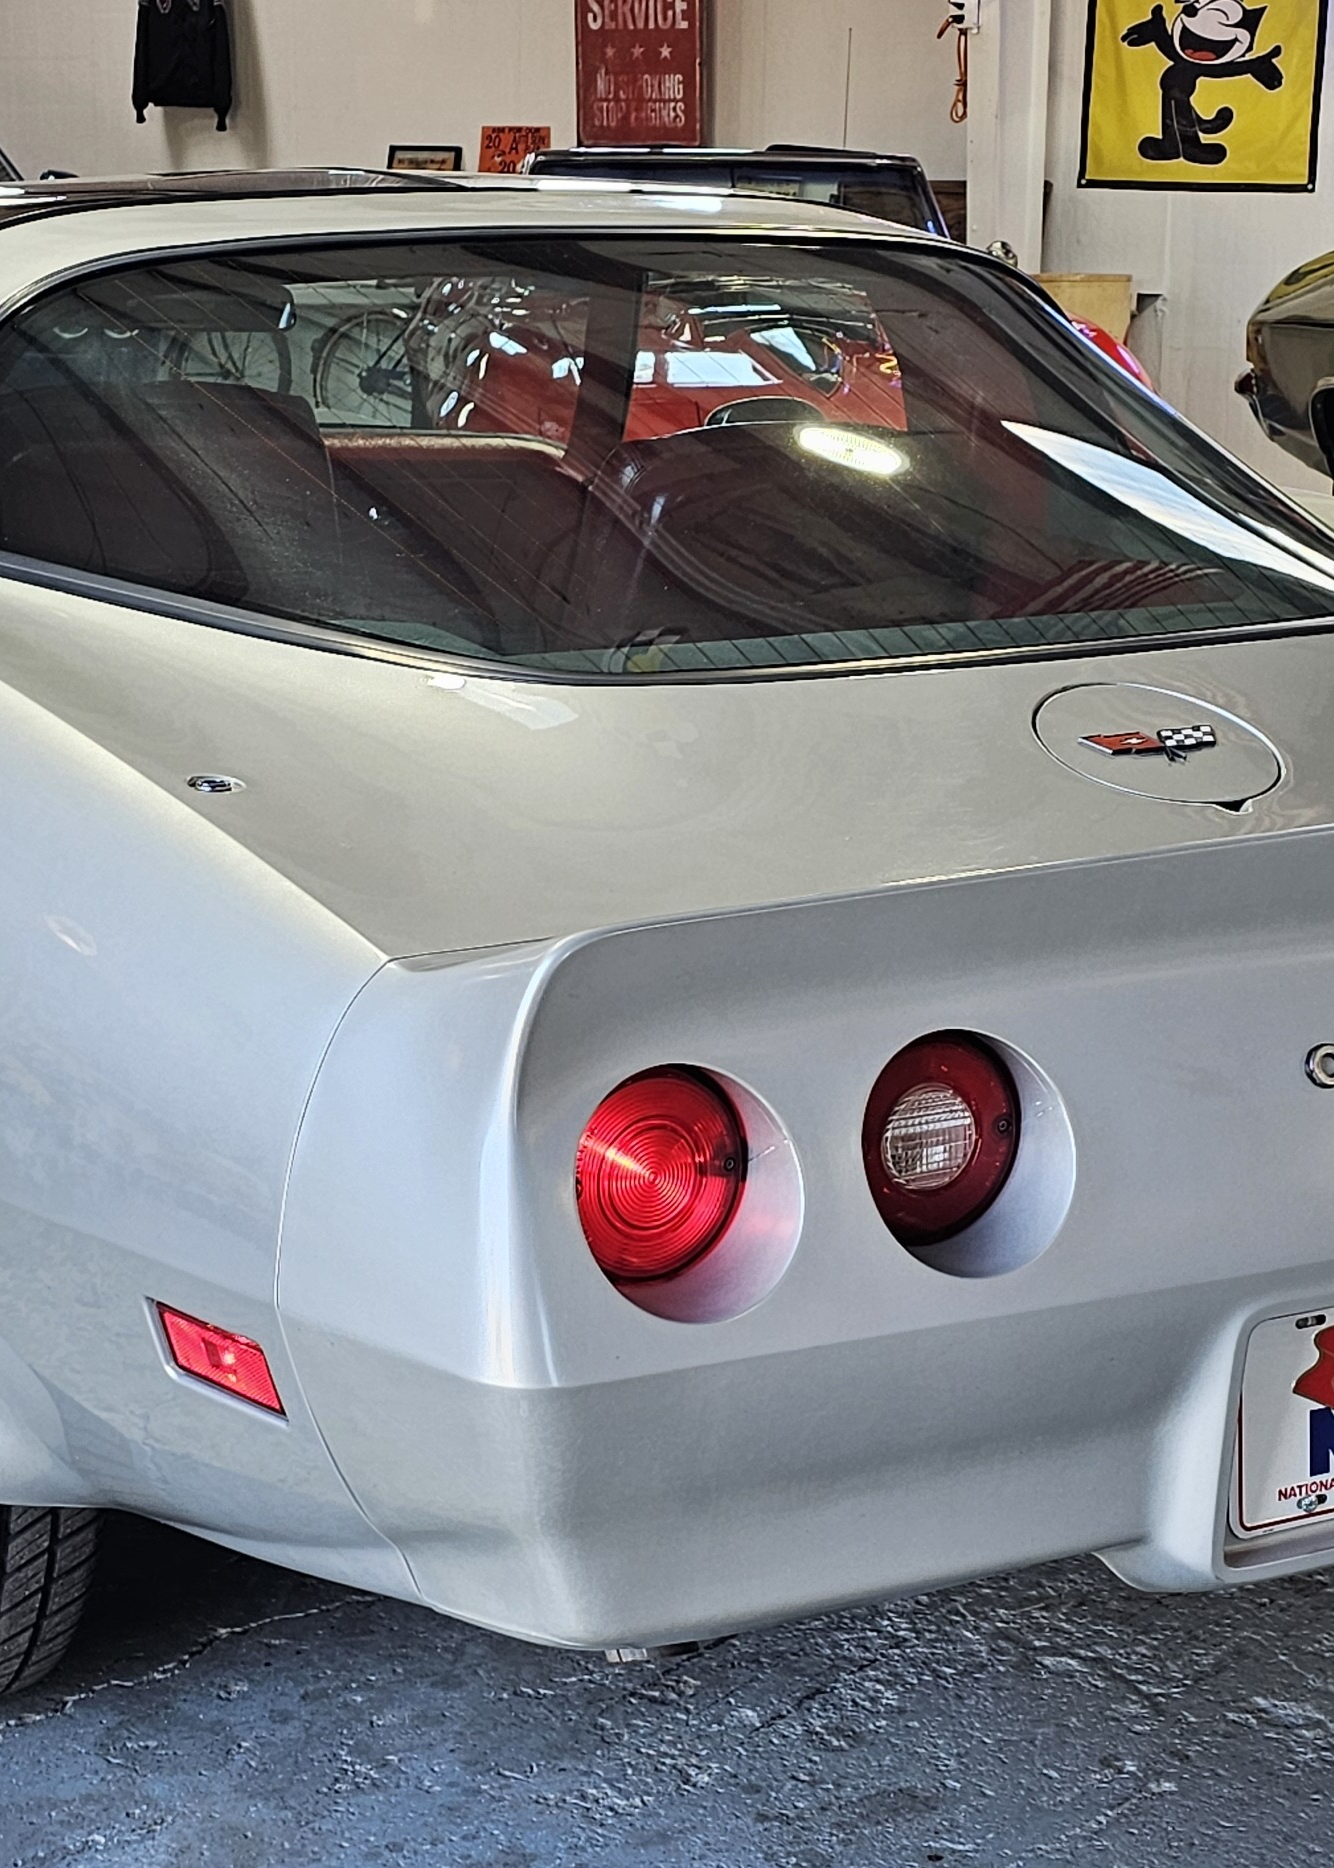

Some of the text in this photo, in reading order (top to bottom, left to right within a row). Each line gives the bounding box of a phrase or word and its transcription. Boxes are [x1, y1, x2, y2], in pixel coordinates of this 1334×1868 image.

[587, 0, 689, 30] SERVICE
[596, 70, 615, 99] NO
[593, 101, 627, 127] STOP
[485, 134, 502, 149] 20
